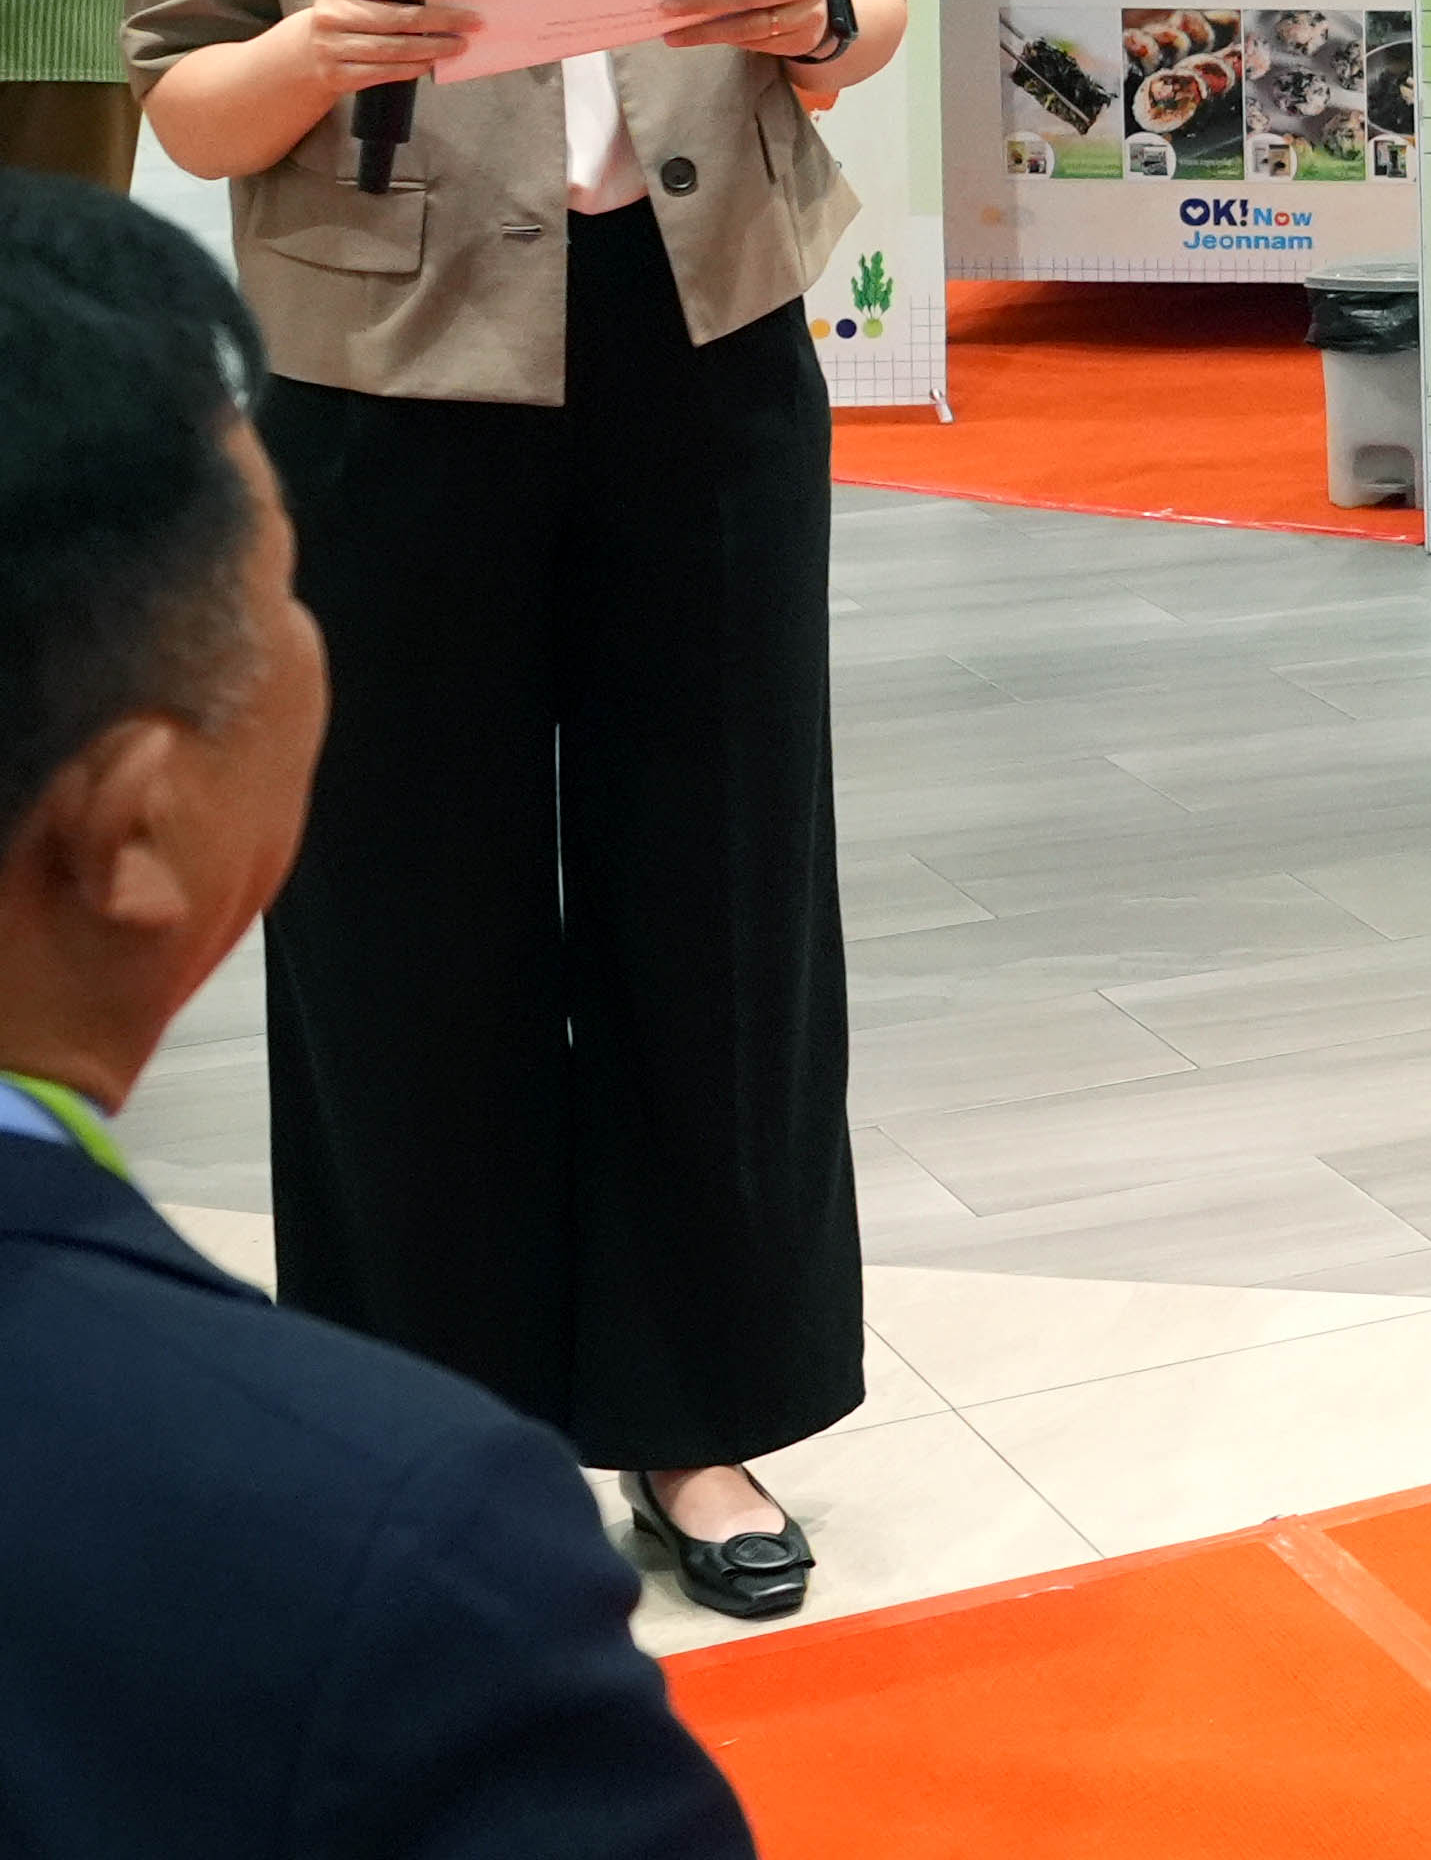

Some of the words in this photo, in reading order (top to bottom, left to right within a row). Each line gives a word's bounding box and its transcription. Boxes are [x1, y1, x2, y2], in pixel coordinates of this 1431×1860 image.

[1179, 197, 1249, 228] OK!
[1253, 207, 1313, 227] Now
[1183, 230, 1313, 251] Jeonnam
